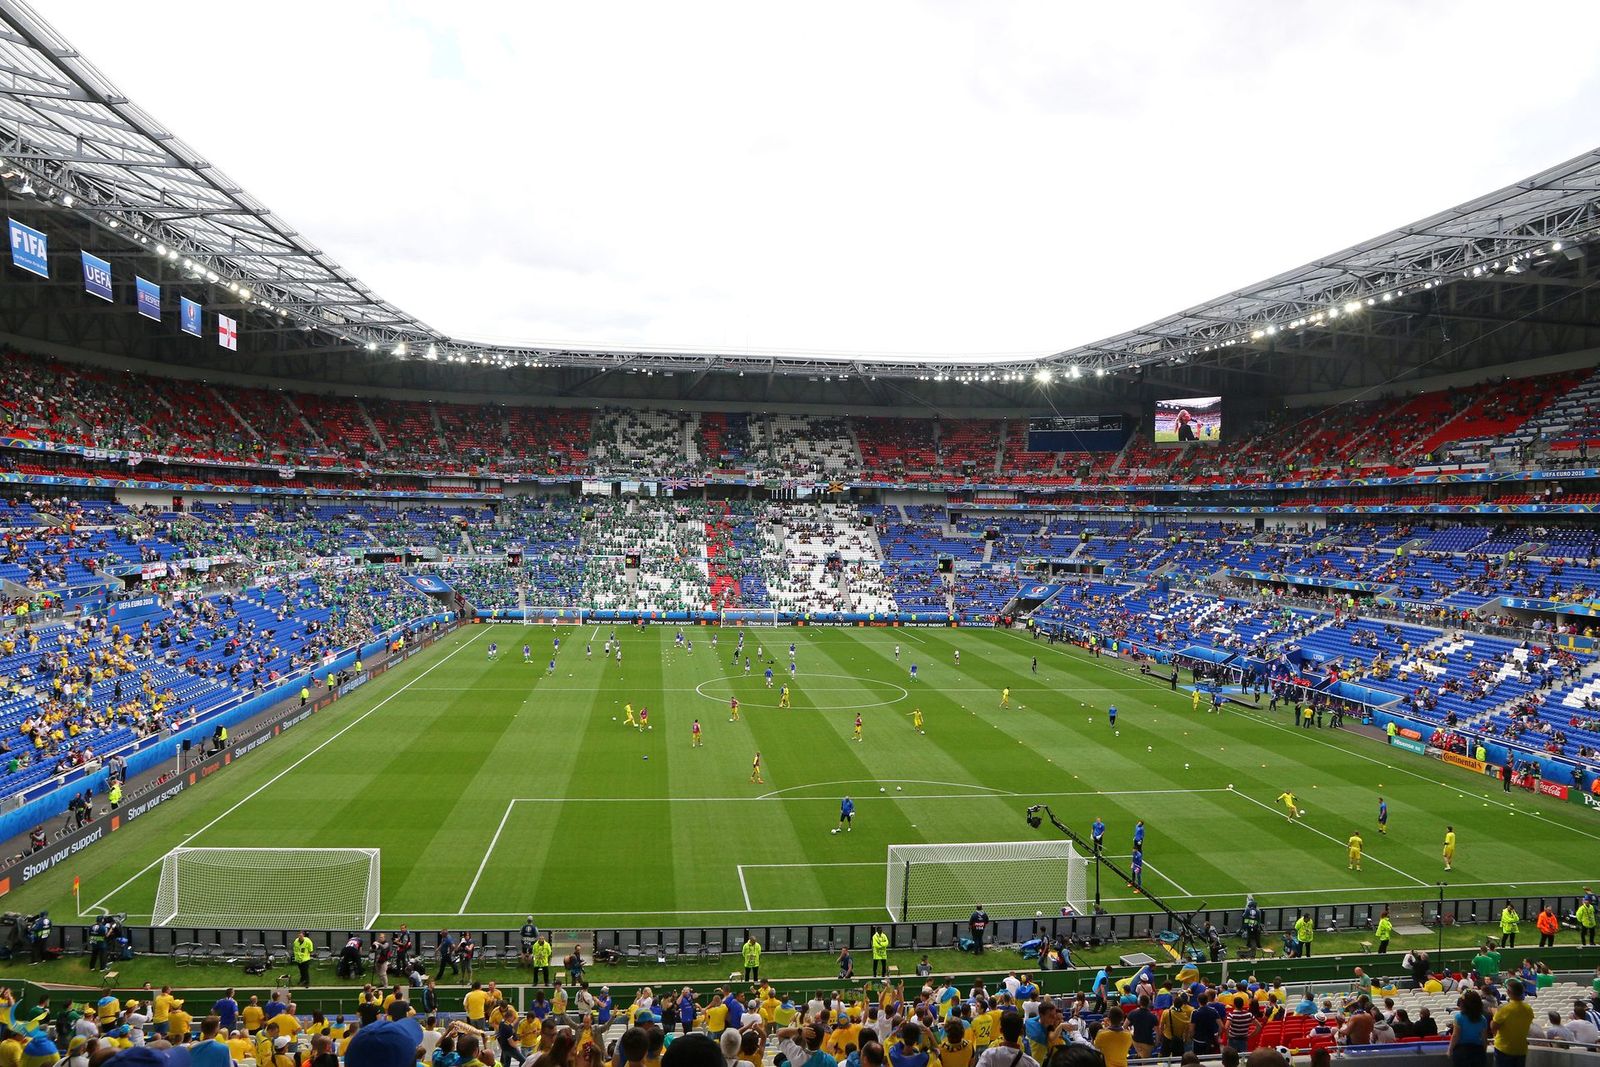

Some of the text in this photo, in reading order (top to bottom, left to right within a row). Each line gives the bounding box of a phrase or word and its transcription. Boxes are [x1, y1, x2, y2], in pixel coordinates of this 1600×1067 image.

[11, 226, 47, 261] FIFA
[86, 264, 112, 289] UEFA
[143, 598, 153, 606] 2016
[282, 708, 312, 730] Show your support
[235, 731, 272, 758] Show your support
[1443, 752, 1477, 769] Continental
[128, 780, 183, 821] Show your support
[23, 826, 102, 881] Show your support
[979, 1026, 992, 1038] 24
